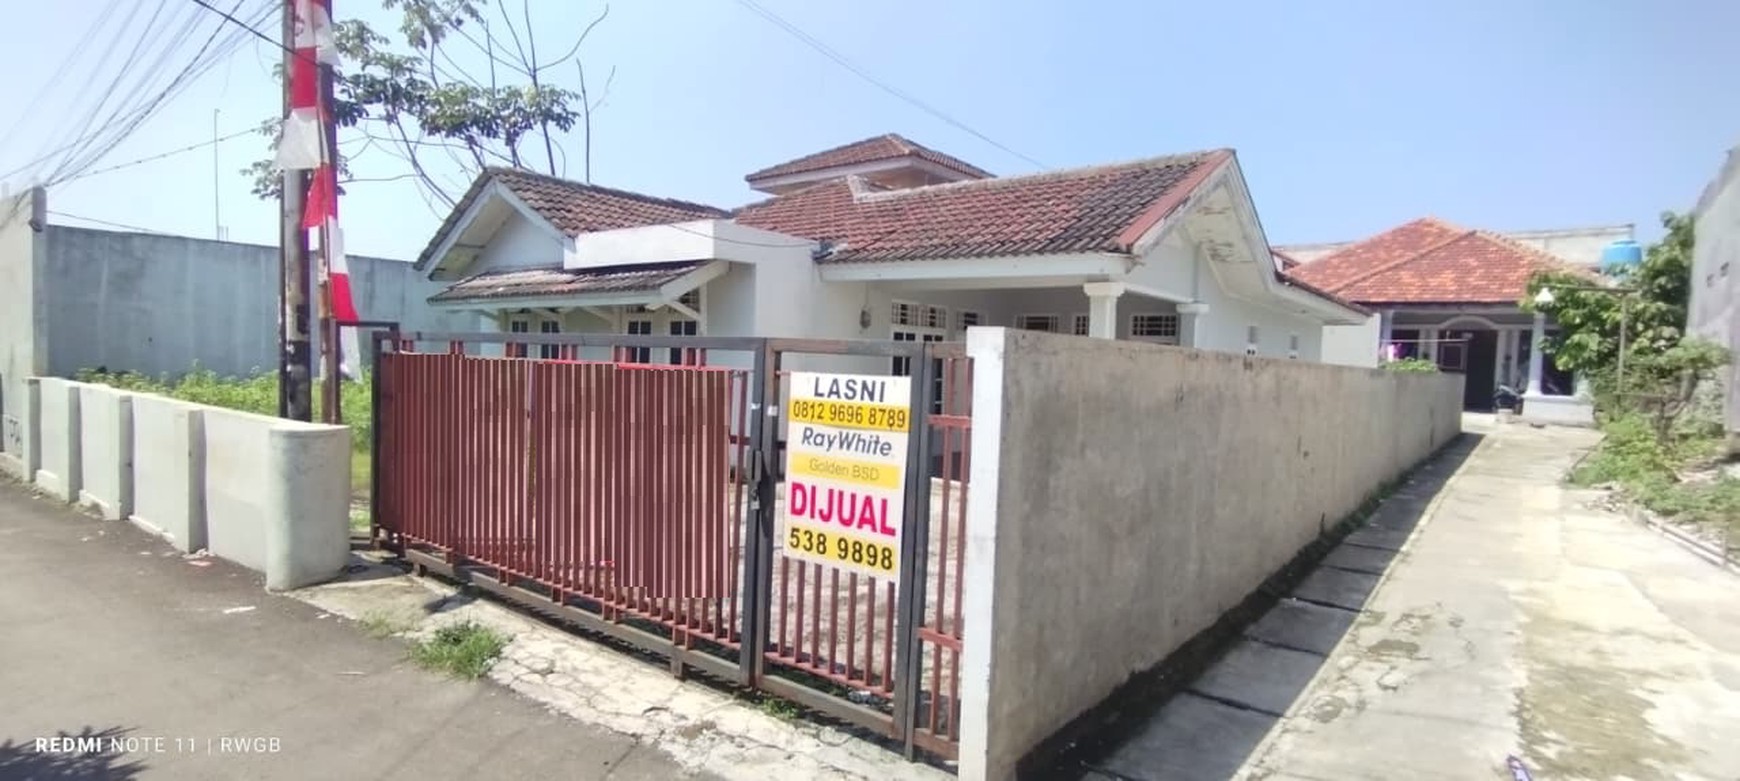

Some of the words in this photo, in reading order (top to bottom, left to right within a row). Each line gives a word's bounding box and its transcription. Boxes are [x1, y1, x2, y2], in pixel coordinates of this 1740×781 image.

[814, 376, 885, 402] LASNI
[793, 401, 825, 421] 0812
[829, 405, 864, 425] 9696
[868, 407, 906, 429] 8789
[809, 458, 849, 476] Golden
[853, 463, 880, 481] BSD
[790, 482, 896, 537] DIJUAL
[789, 527, 827, 555] 538
[837, 537, 893, 571] 9898
